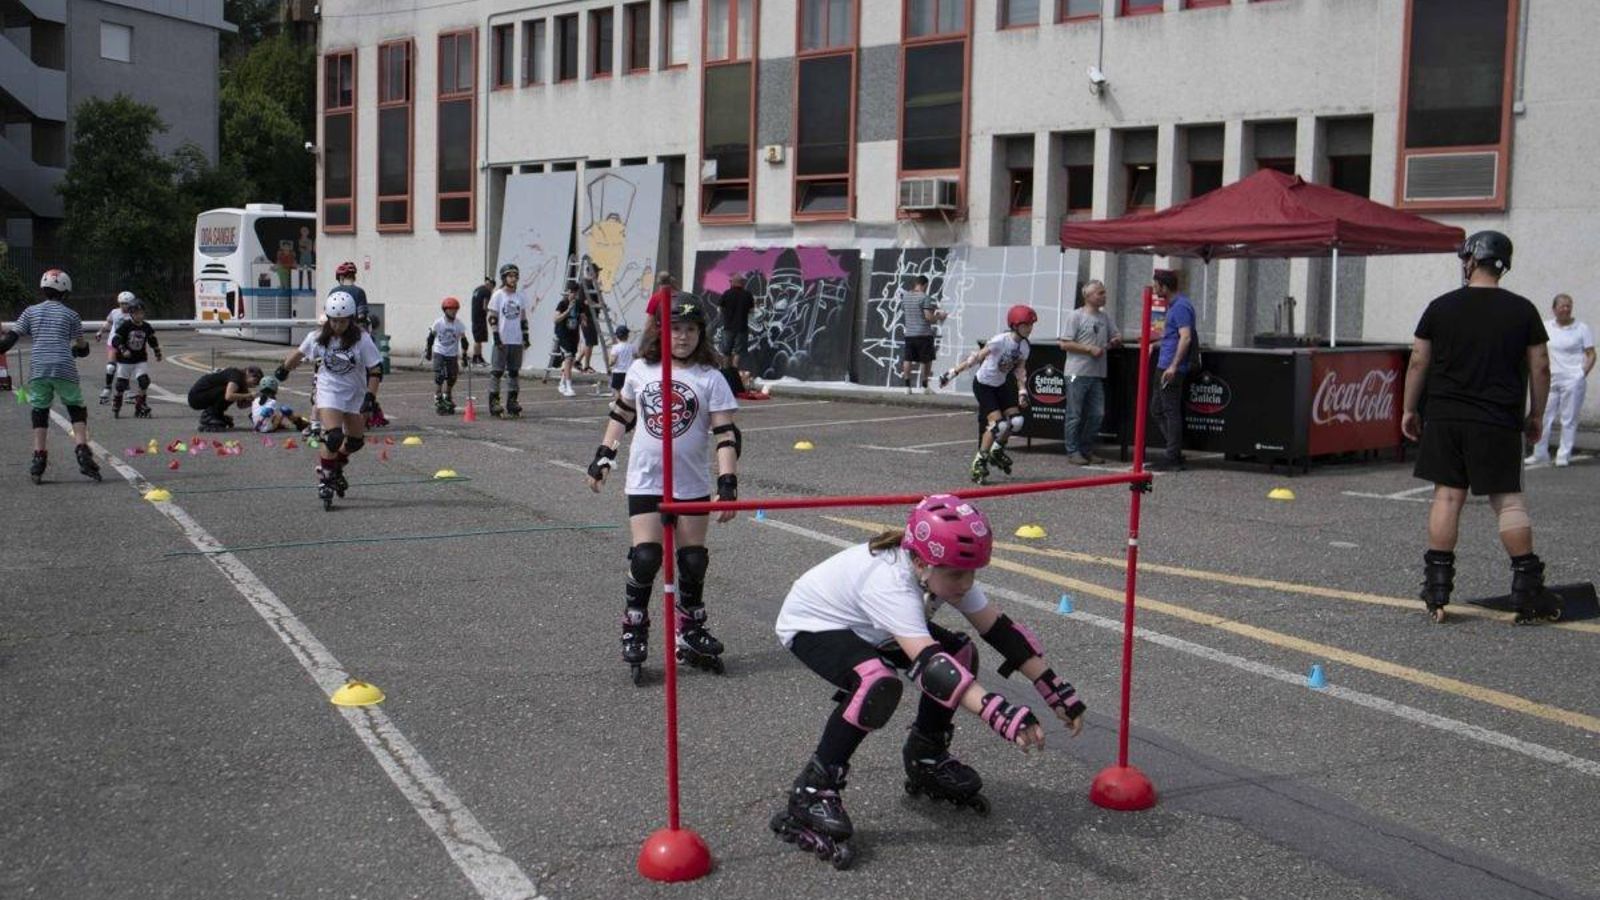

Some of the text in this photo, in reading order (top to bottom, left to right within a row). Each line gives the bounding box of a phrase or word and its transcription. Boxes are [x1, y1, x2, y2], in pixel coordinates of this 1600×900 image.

[1035, 375, 1064, 386] Estrella
[1035, 384, 1062, 394] Galicia
[1190, 383, 1223, 394] Estrella
[1191, 393, 1221, 405] Galicia
[1312, 369, 1399, 425] Coca-Cola
